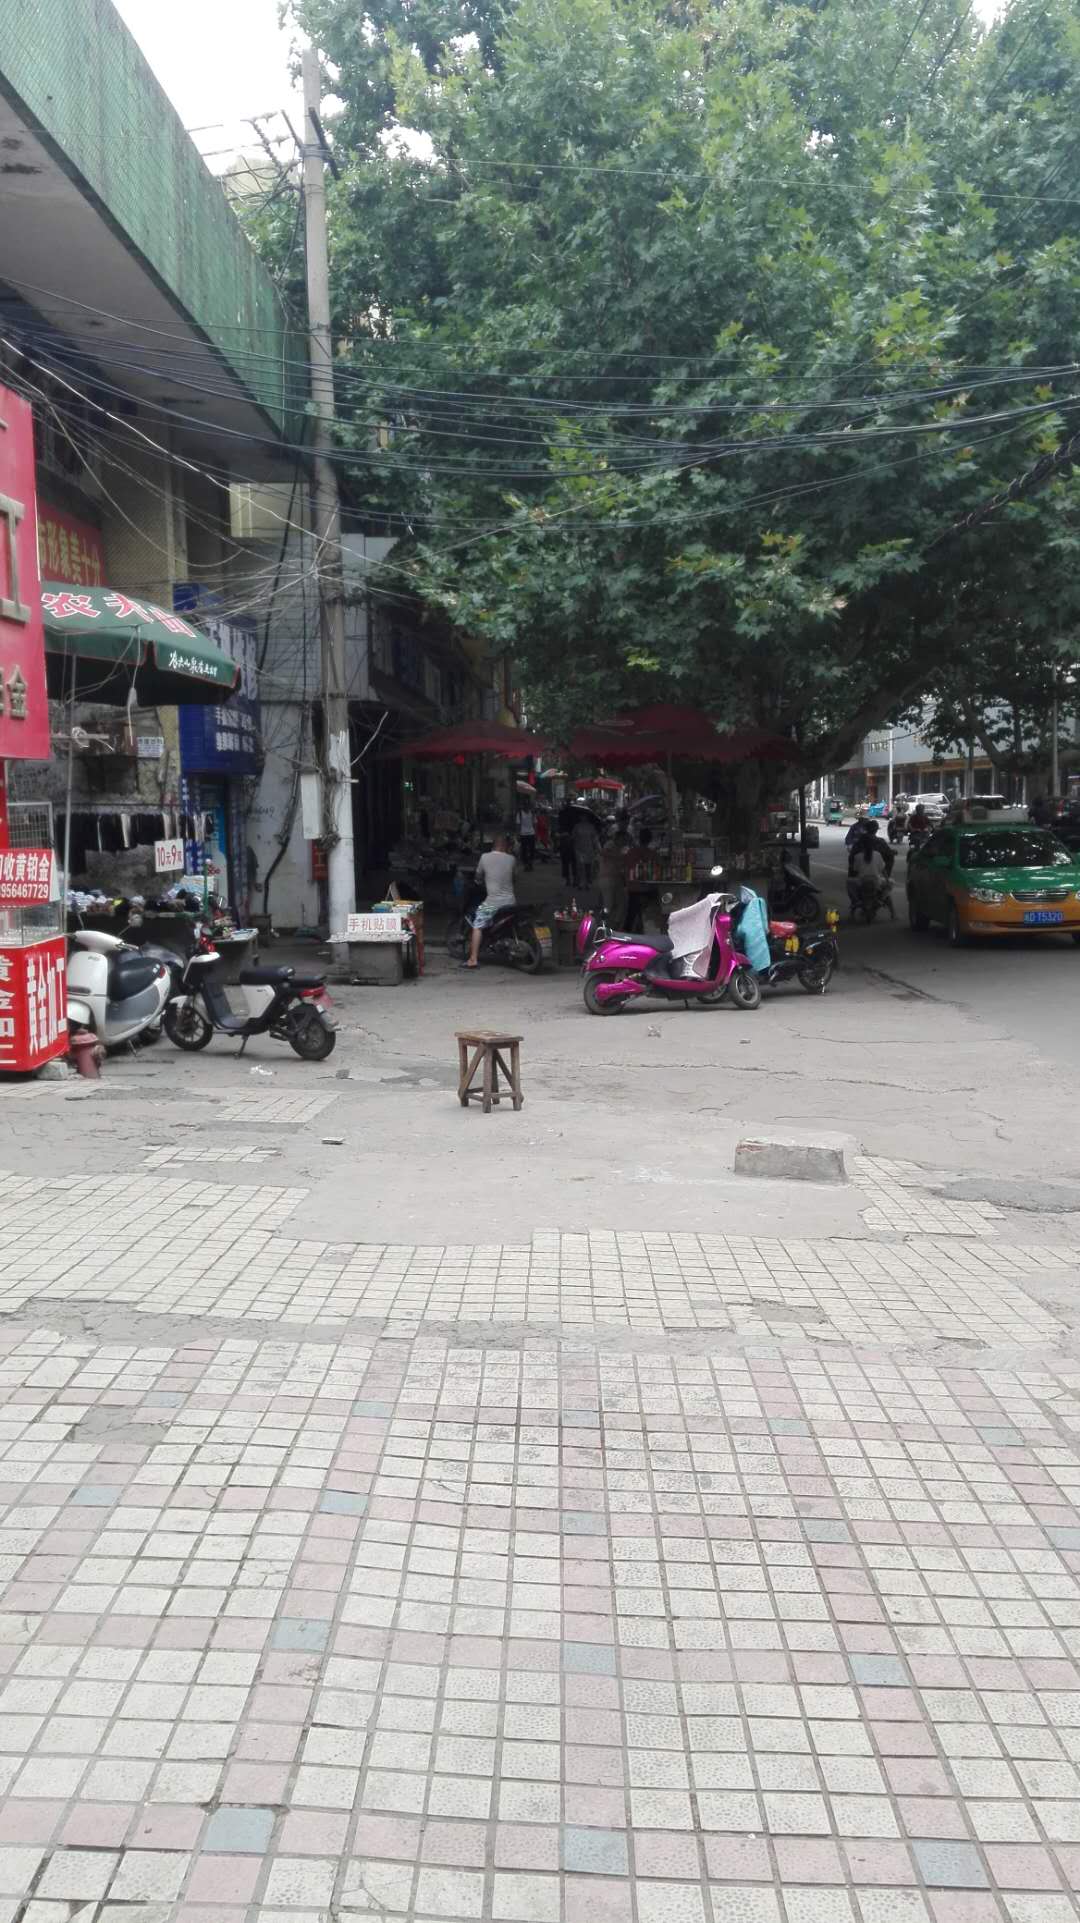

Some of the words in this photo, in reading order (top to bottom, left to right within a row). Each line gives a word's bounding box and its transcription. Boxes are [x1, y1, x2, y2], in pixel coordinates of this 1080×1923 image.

[0, 658, 28, 719] 金
[0, 884, 48, 898] 956467729
[27, 952, 67, 1056] 黄金加工
